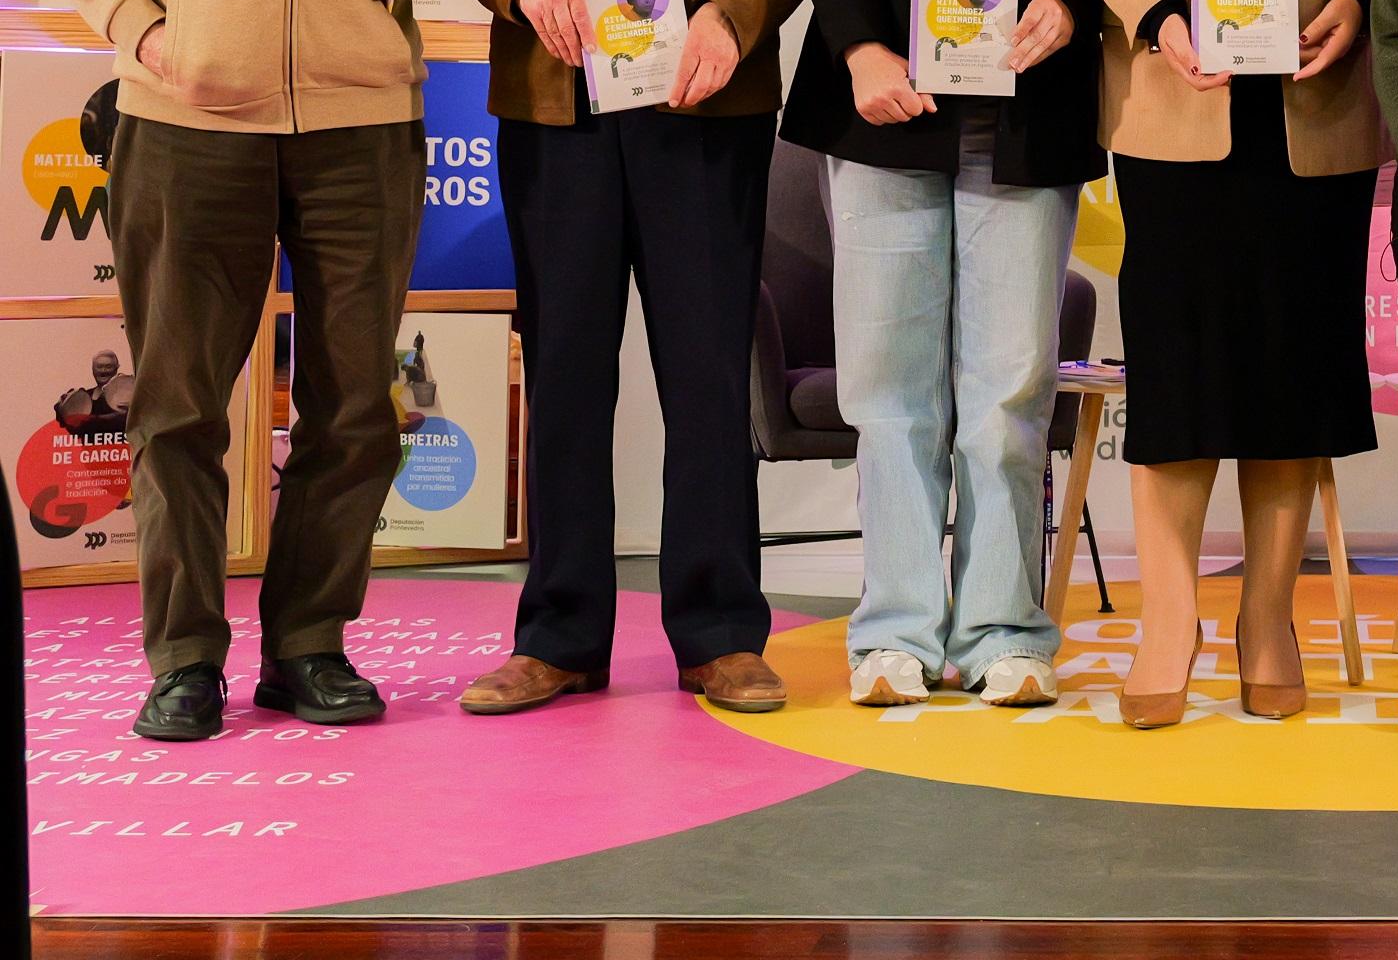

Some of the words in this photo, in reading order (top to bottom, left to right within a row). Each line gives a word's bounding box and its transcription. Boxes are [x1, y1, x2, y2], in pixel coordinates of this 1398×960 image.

[425, 136, 492, 168] TOS
[34, 154, 103, 168] MATILDE
[423, 176, 491, 207] ROS
[399, 433, 459, 448] BREIRAS
[52, 451, 73, 465] DE
[80, 448, 132, 464] GARGA
[27, 771, 356, 786] IMADELOS
[31, 820, 299, 837] VILLAR
